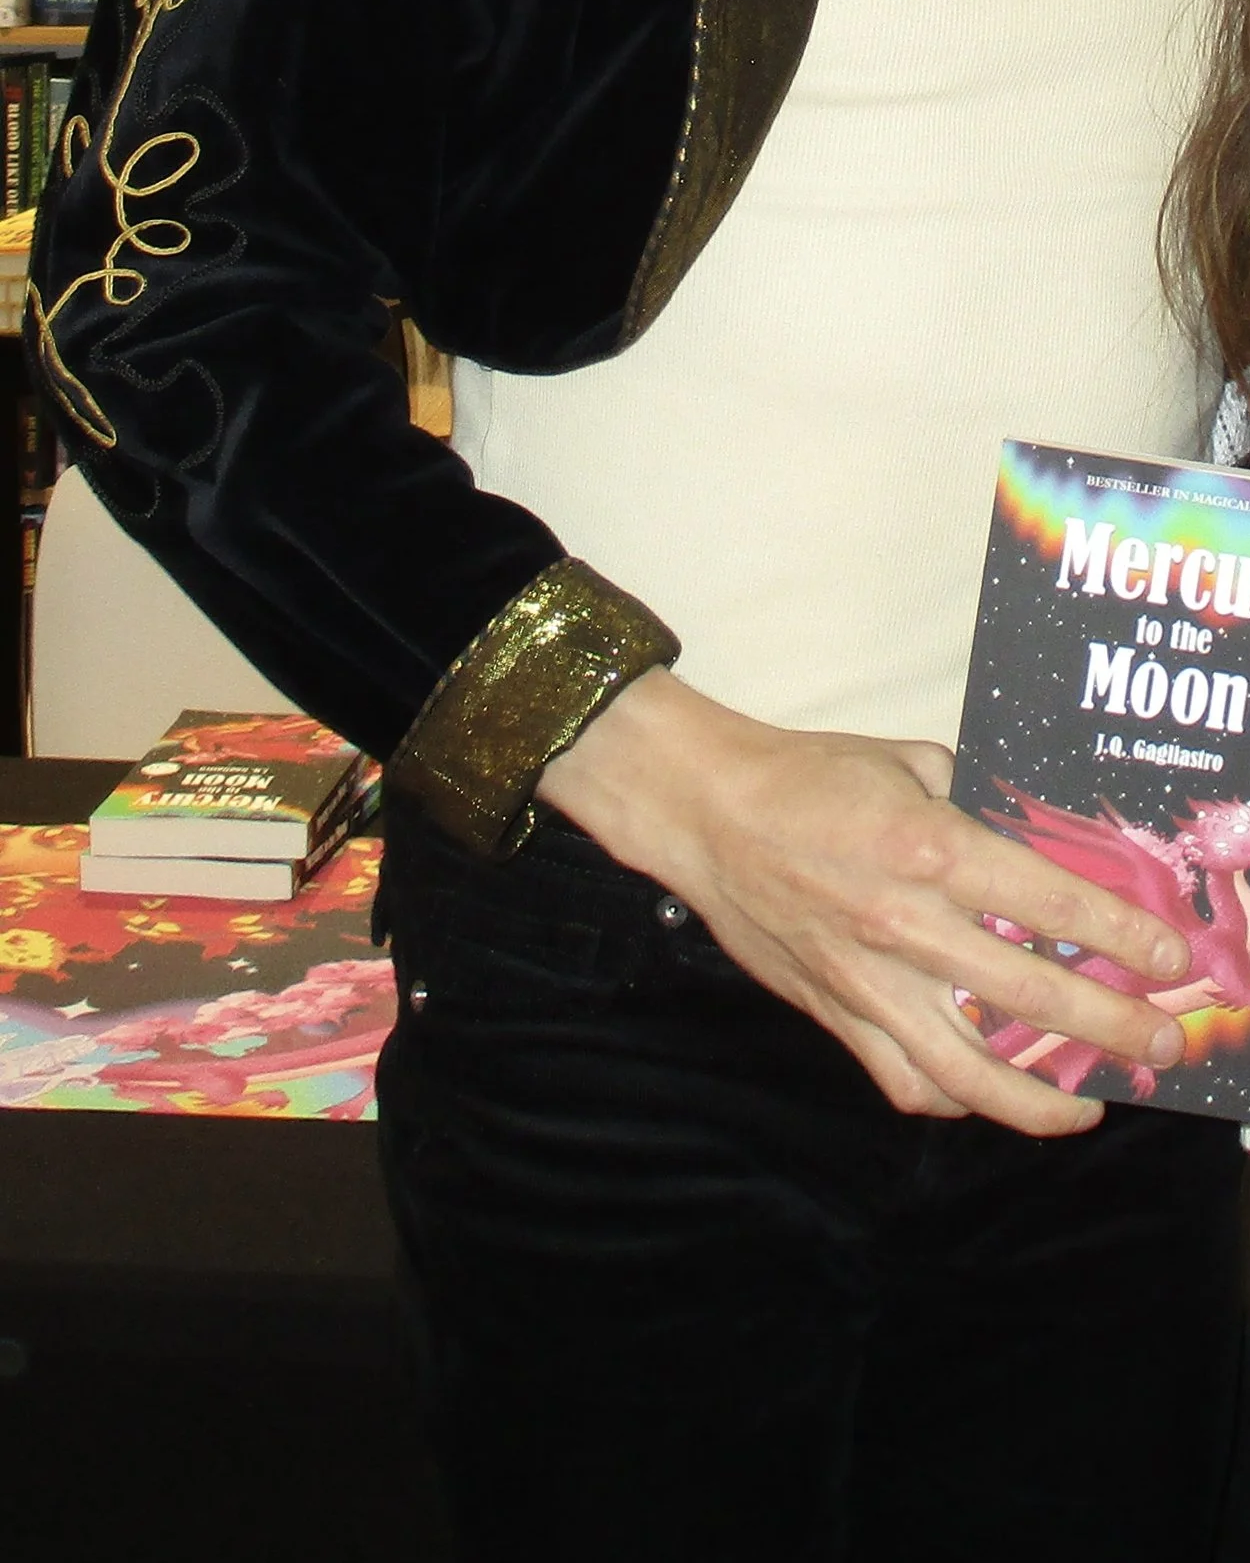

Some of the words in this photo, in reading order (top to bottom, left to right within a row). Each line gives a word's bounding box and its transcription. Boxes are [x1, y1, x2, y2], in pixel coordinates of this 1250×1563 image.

[7, 102, 21, 152] BLOOD
[7, 153, 20, 187] LIKE
[1086, 475, 1171, 499] BESTSELLER
[1173, 489, 1190, 501] IN
[1136, 614, 1164, 646] to
[1169, 619, 1214, 655] the
[1080, 641, 1250, 734] Moon
[1133, 739, 1225, 774] Gagliastro
[181, 774, 275, 789] Moon
[132, 791, 283, 812] Mercury
